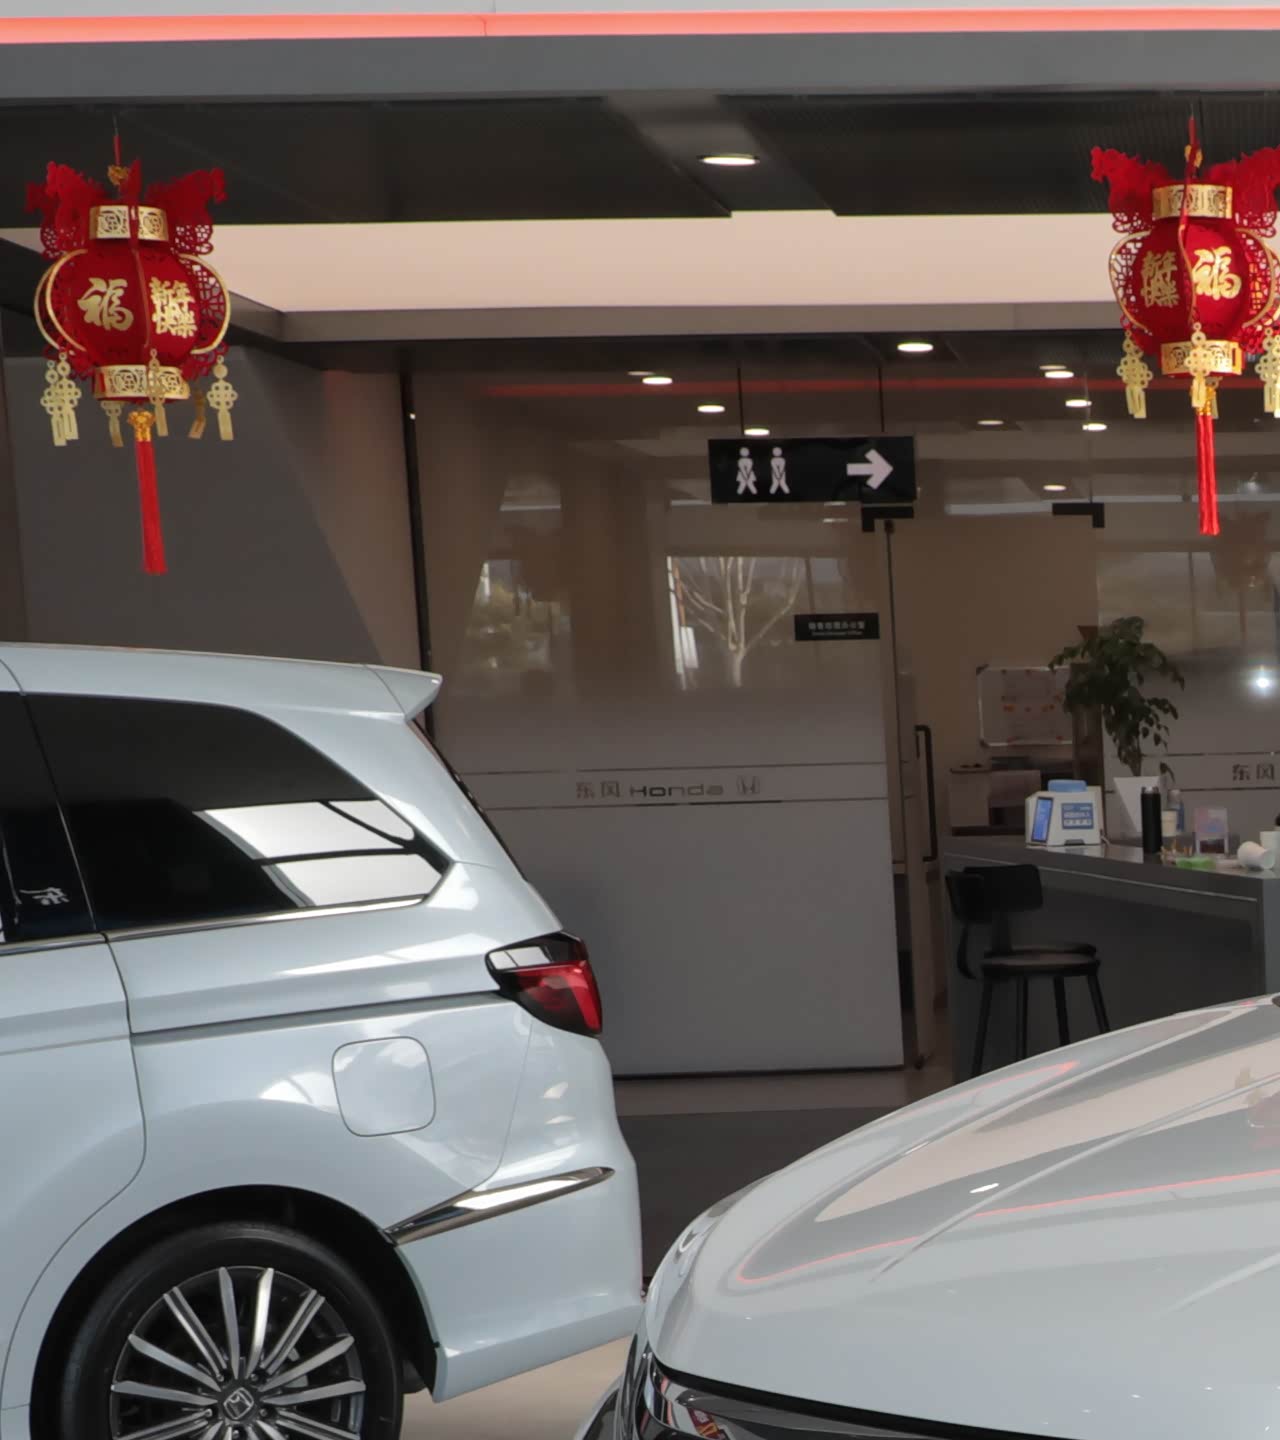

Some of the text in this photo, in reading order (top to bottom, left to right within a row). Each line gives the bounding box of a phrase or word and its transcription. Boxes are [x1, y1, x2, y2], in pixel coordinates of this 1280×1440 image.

[1192, 246, 1242, 301] 福
[77, 278, 134, 331] 福
[630, 783, 724, 798] Honda
